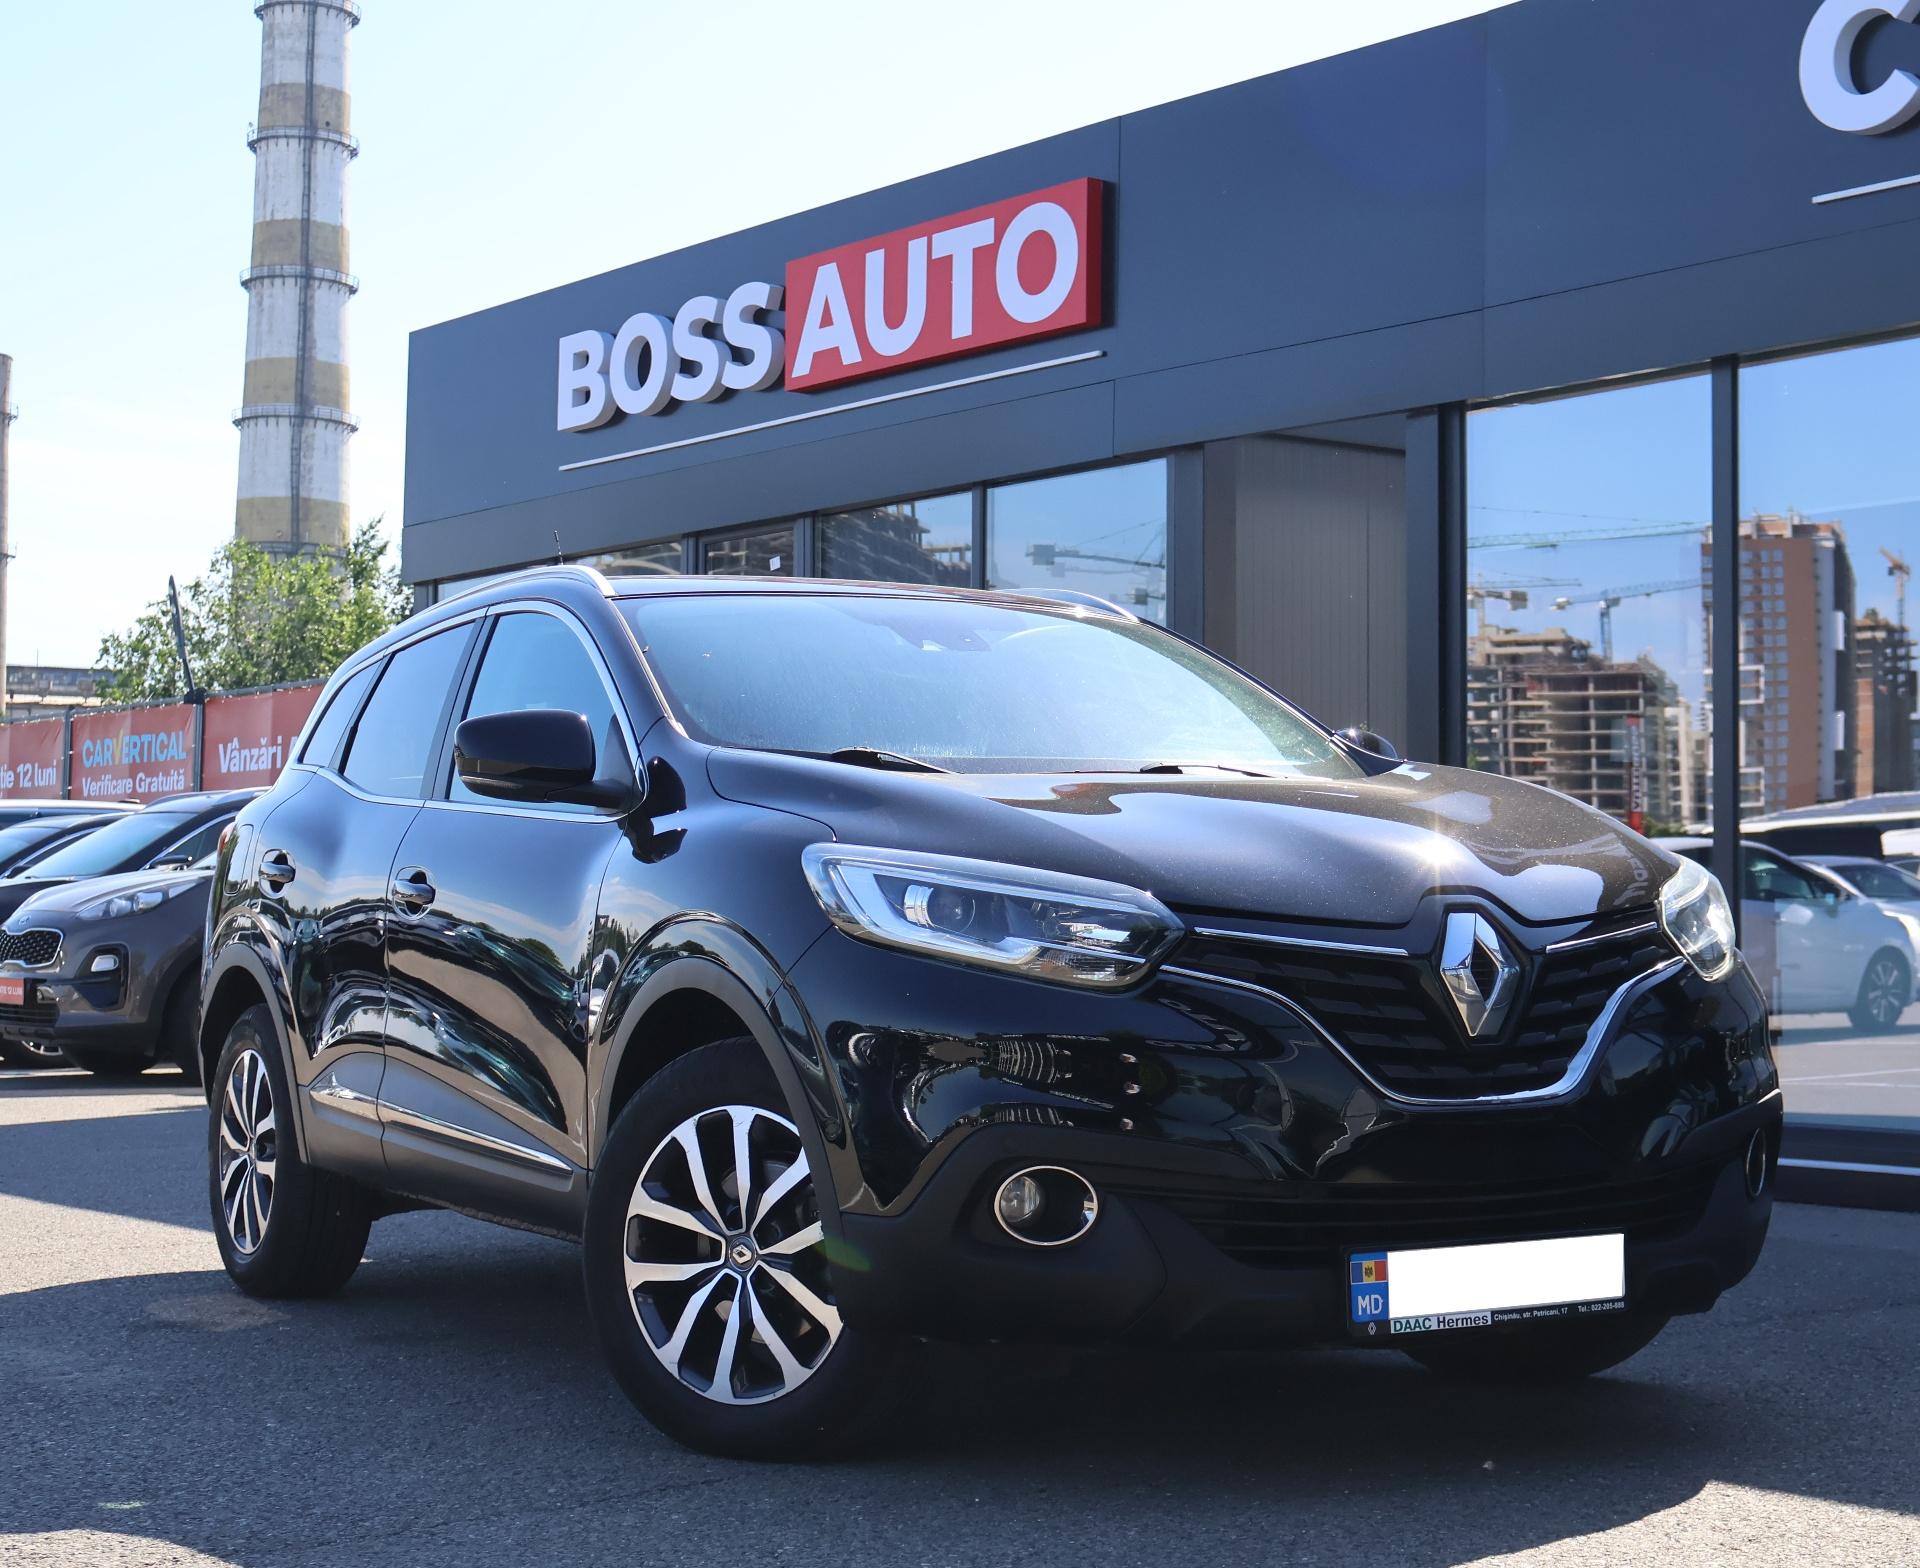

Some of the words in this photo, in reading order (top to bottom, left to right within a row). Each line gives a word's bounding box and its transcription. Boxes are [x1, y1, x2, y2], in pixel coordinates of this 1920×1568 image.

[557, 281, 785, 432] BOSS
[791, 201, 1079, 378] AUTO
[82, 729, 186, 768] CARVERTICAL
[218, 735, 282, 773] Vânzări
[16, 762, 32, 789] 12
[34, 760, 57, 787] luni
[82, 773, 133, 797] Verificare
[136, 768, 185, 793] Gratuită
[1357, 1294, 1383, 1316] MD
[1393, 1318, 1432, 1333] DAAC
[1437, 1312, 1489, 1329] Hermes
